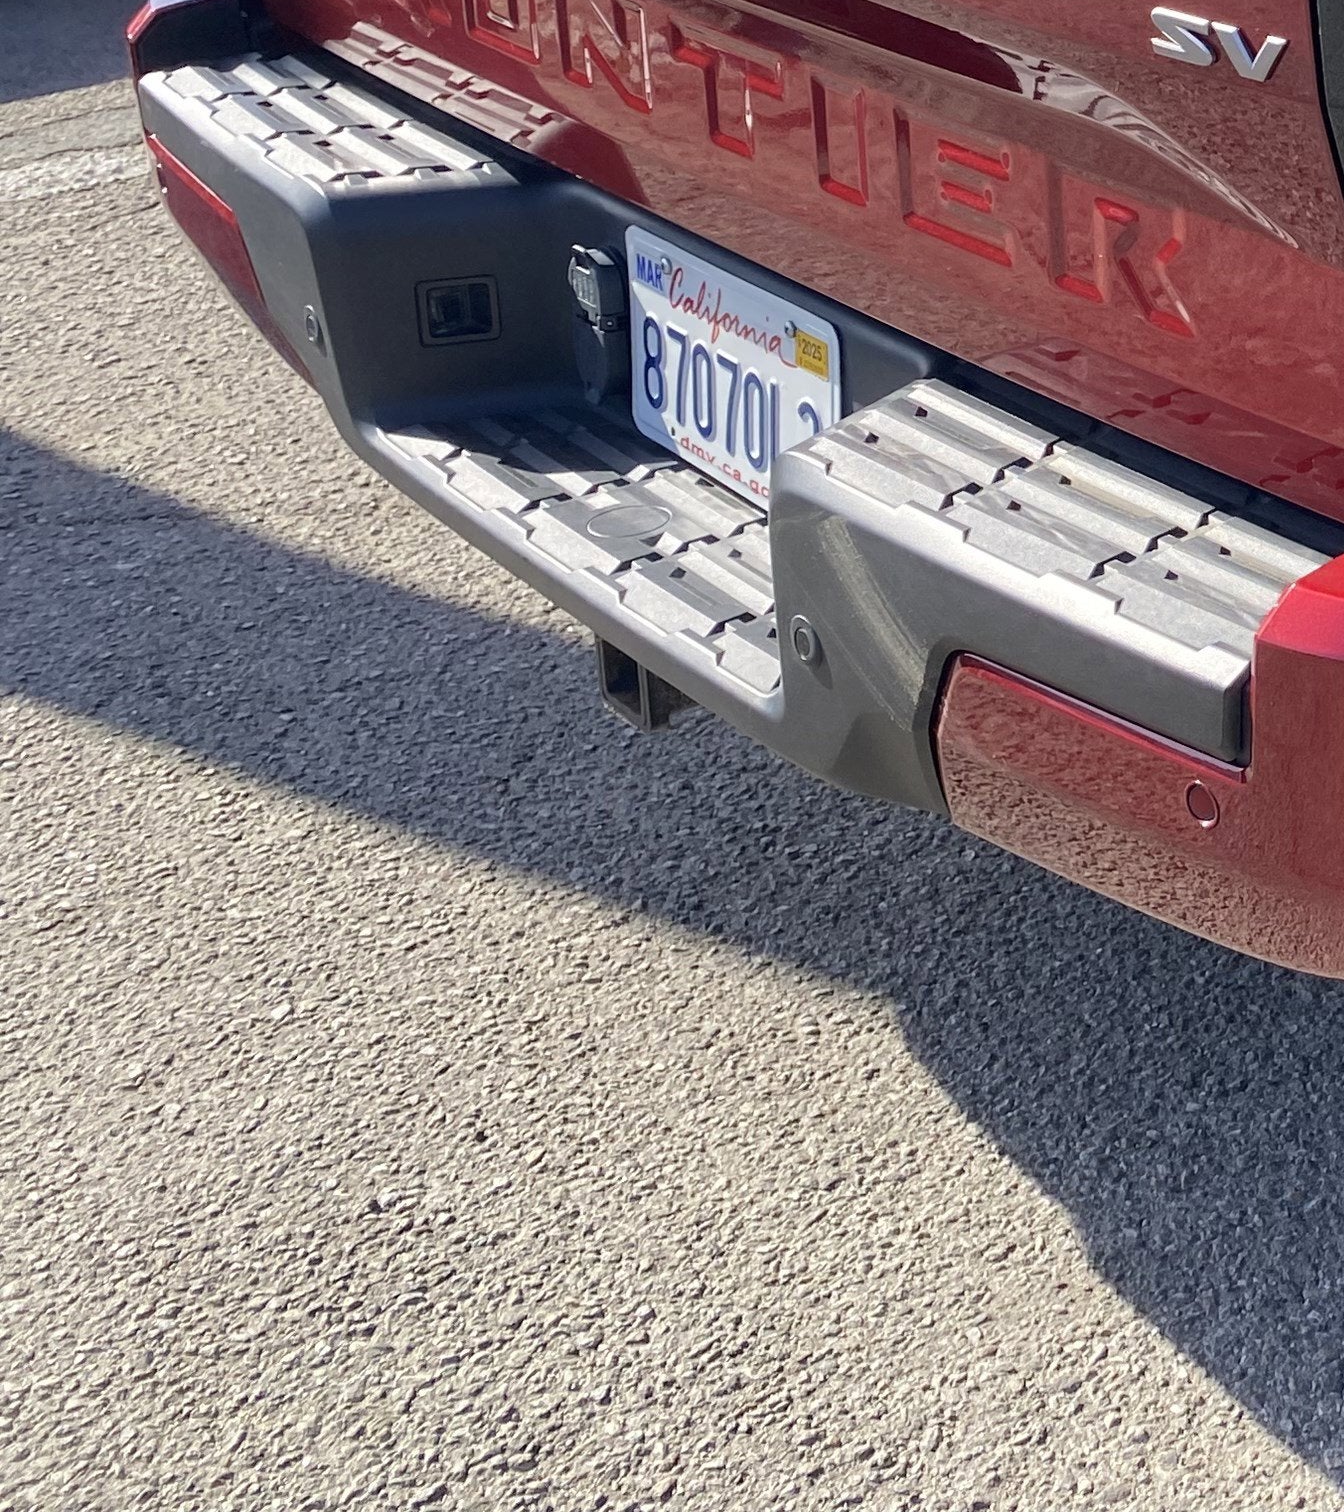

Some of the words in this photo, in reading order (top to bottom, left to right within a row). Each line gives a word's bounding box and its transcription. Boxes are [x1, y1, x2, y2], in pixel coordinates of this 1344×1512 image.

[1150, 6, 1289, 83] SV
[636, 253, 663, 291] MAR
[669, 267, 798, 368] California
[680, 437, 770, 498] dmv.ca.go
